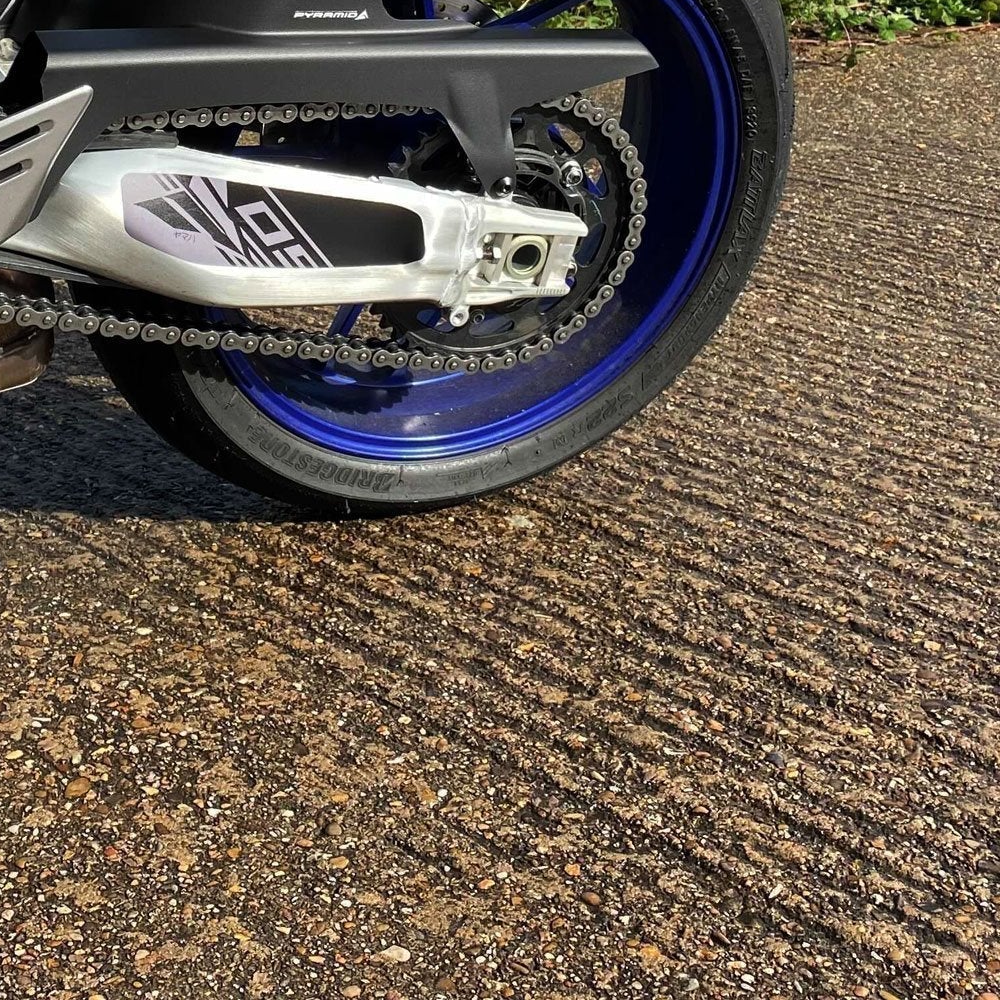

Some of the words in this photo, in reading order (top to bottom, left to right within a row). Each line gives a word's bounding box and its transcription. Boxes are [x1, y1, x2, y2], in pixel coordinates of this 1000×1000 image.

[293, 9, 359, 20] PYRAMID
[731, 148, 776, 268] BATTLAX
[246, 424, 396, 493] BRIDGESTONE
